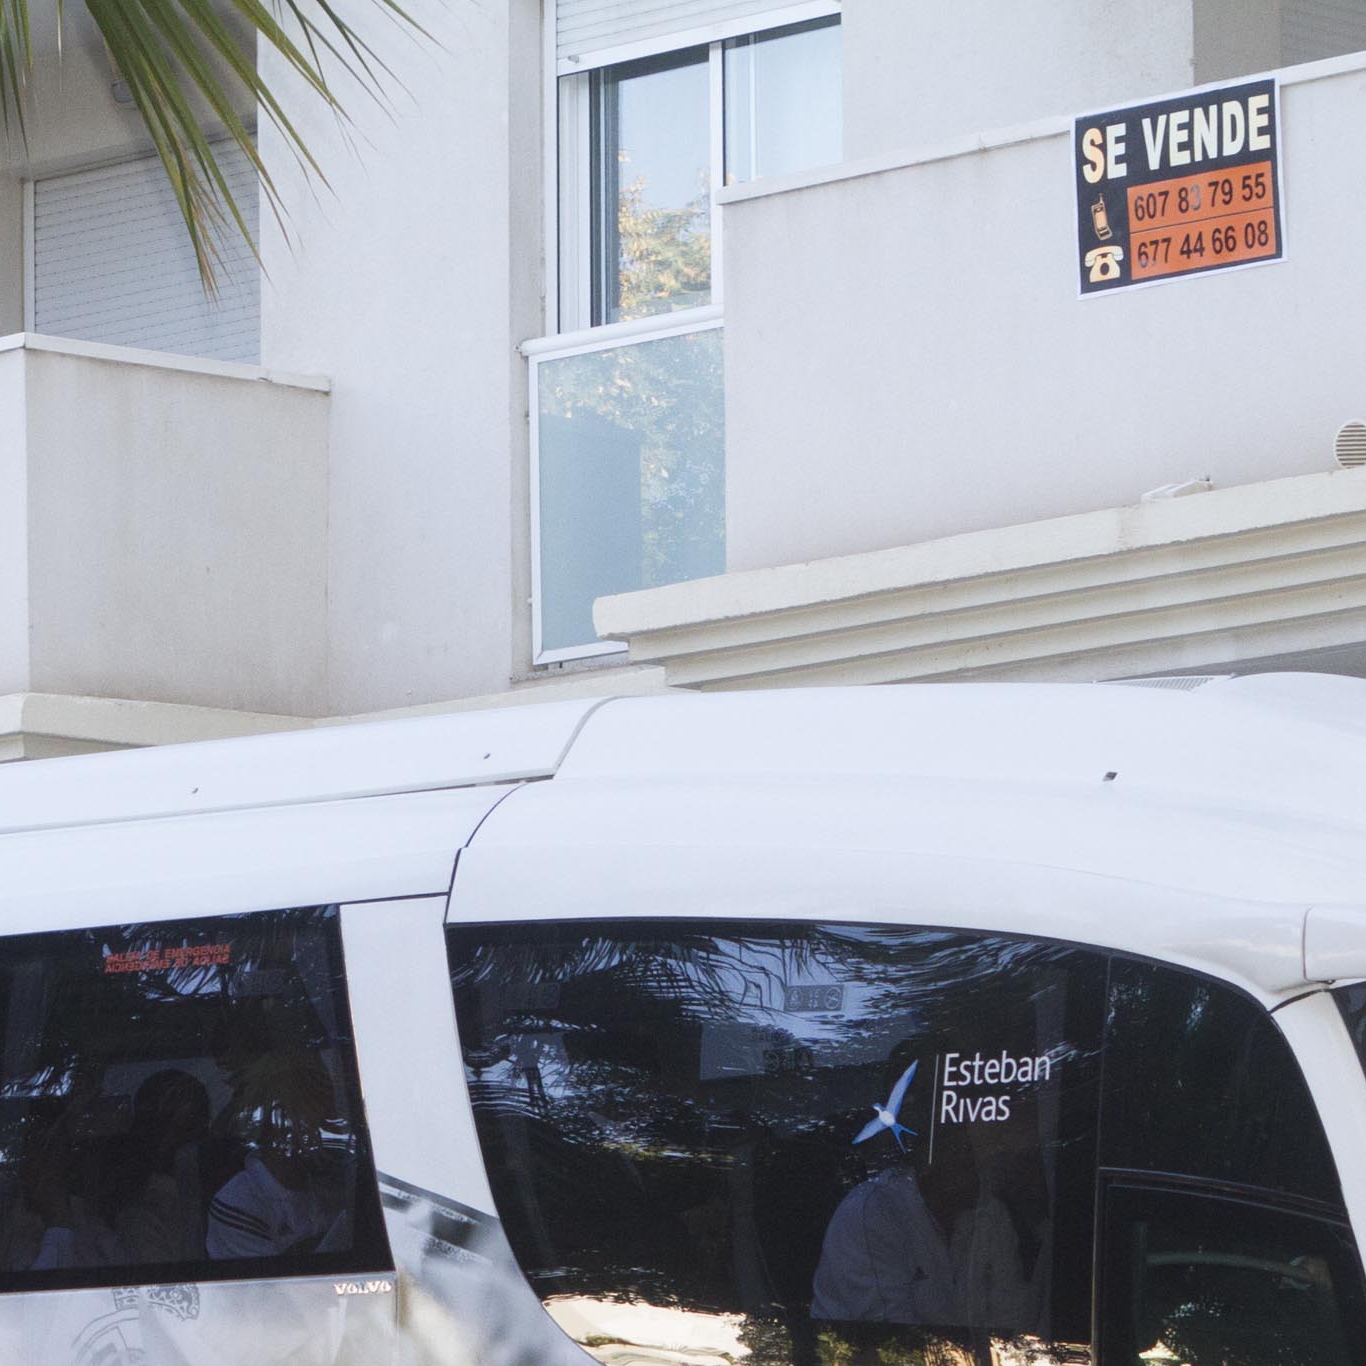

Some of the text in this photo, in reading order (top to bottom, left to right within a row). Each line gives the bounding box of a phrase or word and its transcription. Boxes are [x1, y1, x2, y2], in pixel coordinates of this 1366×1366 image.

[1082, 94, 1271, 183] SE VENDE
[1134, 190, 1170, 221] 607
[1208, 178, 1233, 207] 79
[1242, 172, 1266, 202] 55
[1138, 220, 1268, 268] 677 44 66 08
[943, 1050, 1050, 1087] Esteban
[940, 1090, 1011, 1124] Rivas
[333, 1280, 392, 1296] VOLVO
